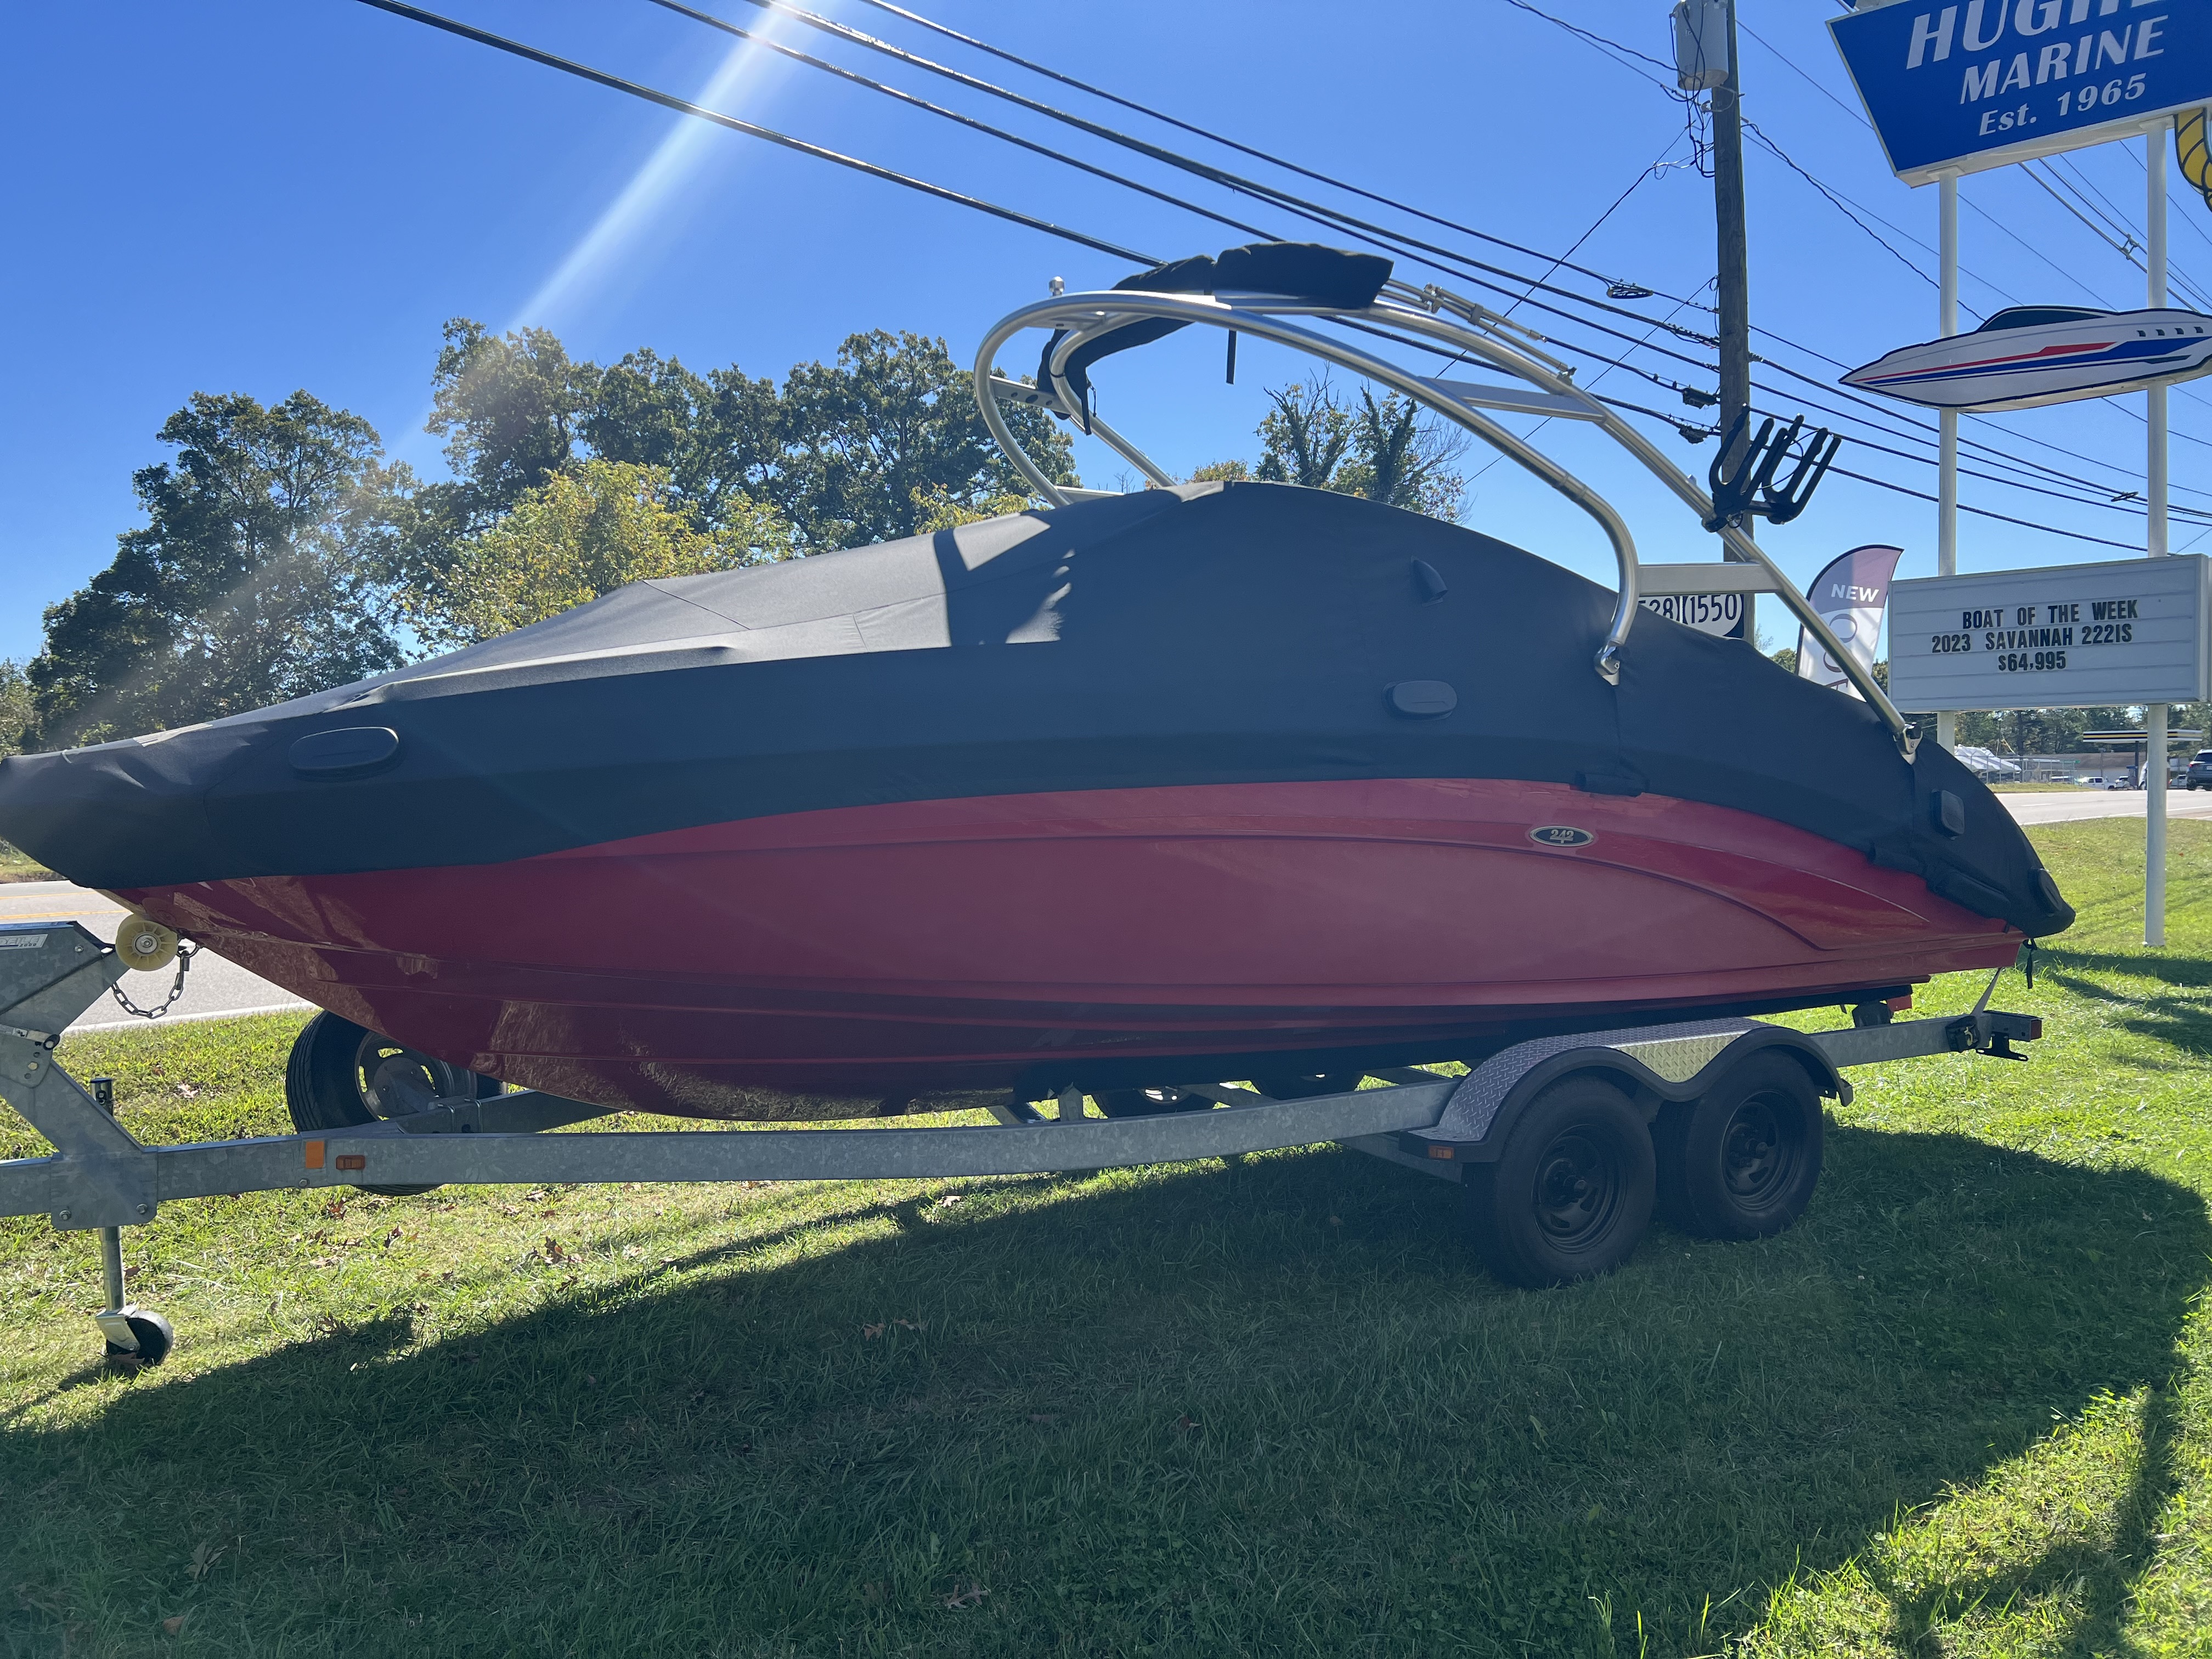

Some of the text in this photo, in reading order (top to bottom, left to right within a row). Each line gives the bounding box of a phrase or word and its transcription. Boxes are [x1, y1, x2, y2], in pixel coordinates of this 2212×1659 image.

[1906, 0, 2162, 69] HUG
[1960, 15, 2168, 104] MARINE
[1979, 73, 2146, 136] Est. 1965
[1831, 583, 1879, 602] NEW
[1639, 594, 1737, 624] 28 1550
[1962, 600, 2138, 629] BOAT OF THE WEEK
[1932, 624, 2132, 653] 2023 SAVANNAH 222IS
[1998, 651, 2066, 672] $64,995
[1549, 829, 1574, 844] 242
